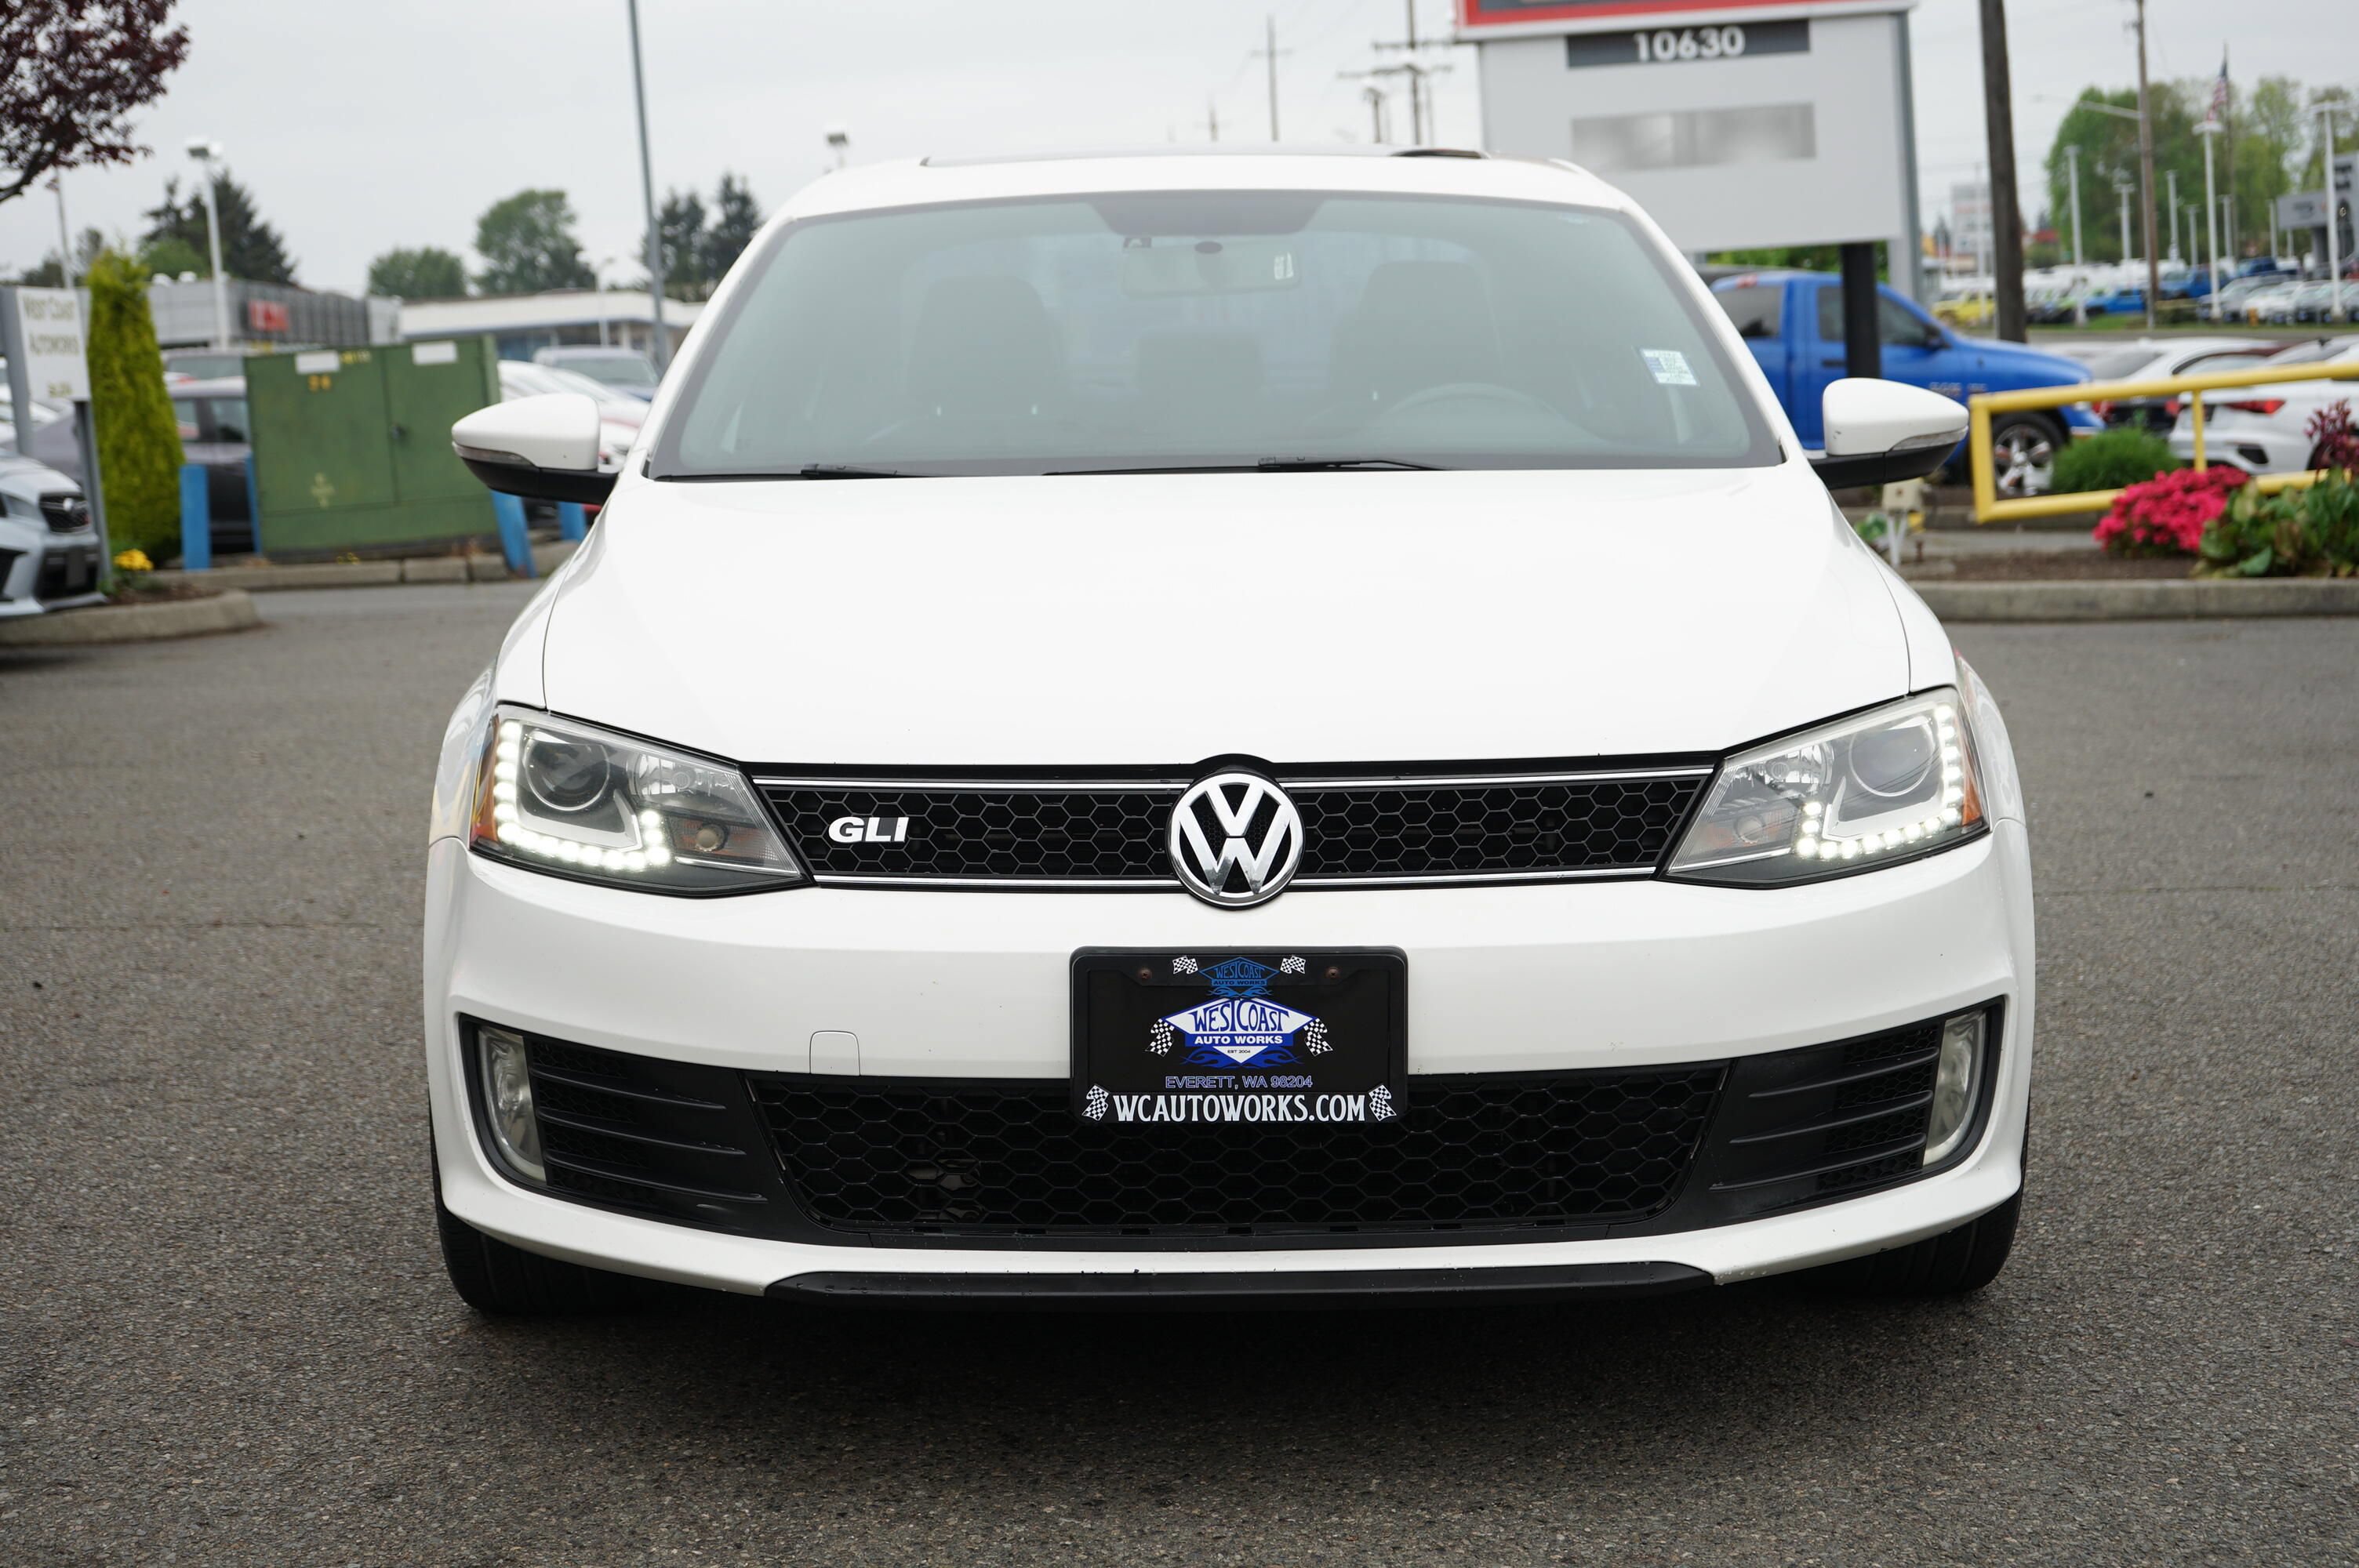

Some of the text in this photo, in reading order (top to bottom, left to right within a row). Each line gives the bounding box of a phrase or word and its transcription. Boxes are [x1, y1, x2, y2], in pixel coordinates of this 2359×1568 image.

[1634, 26, 1746, 62] 10630
[828, 816, 909, 844] GLI
[1194, 1035, 1284, 1045] AUTO WORKS
[1165, 1076, 1313, 1090] EVERETT, WA 98204
[1112, 1094, 1365, 1122] WCAUTOWORKS.COM
